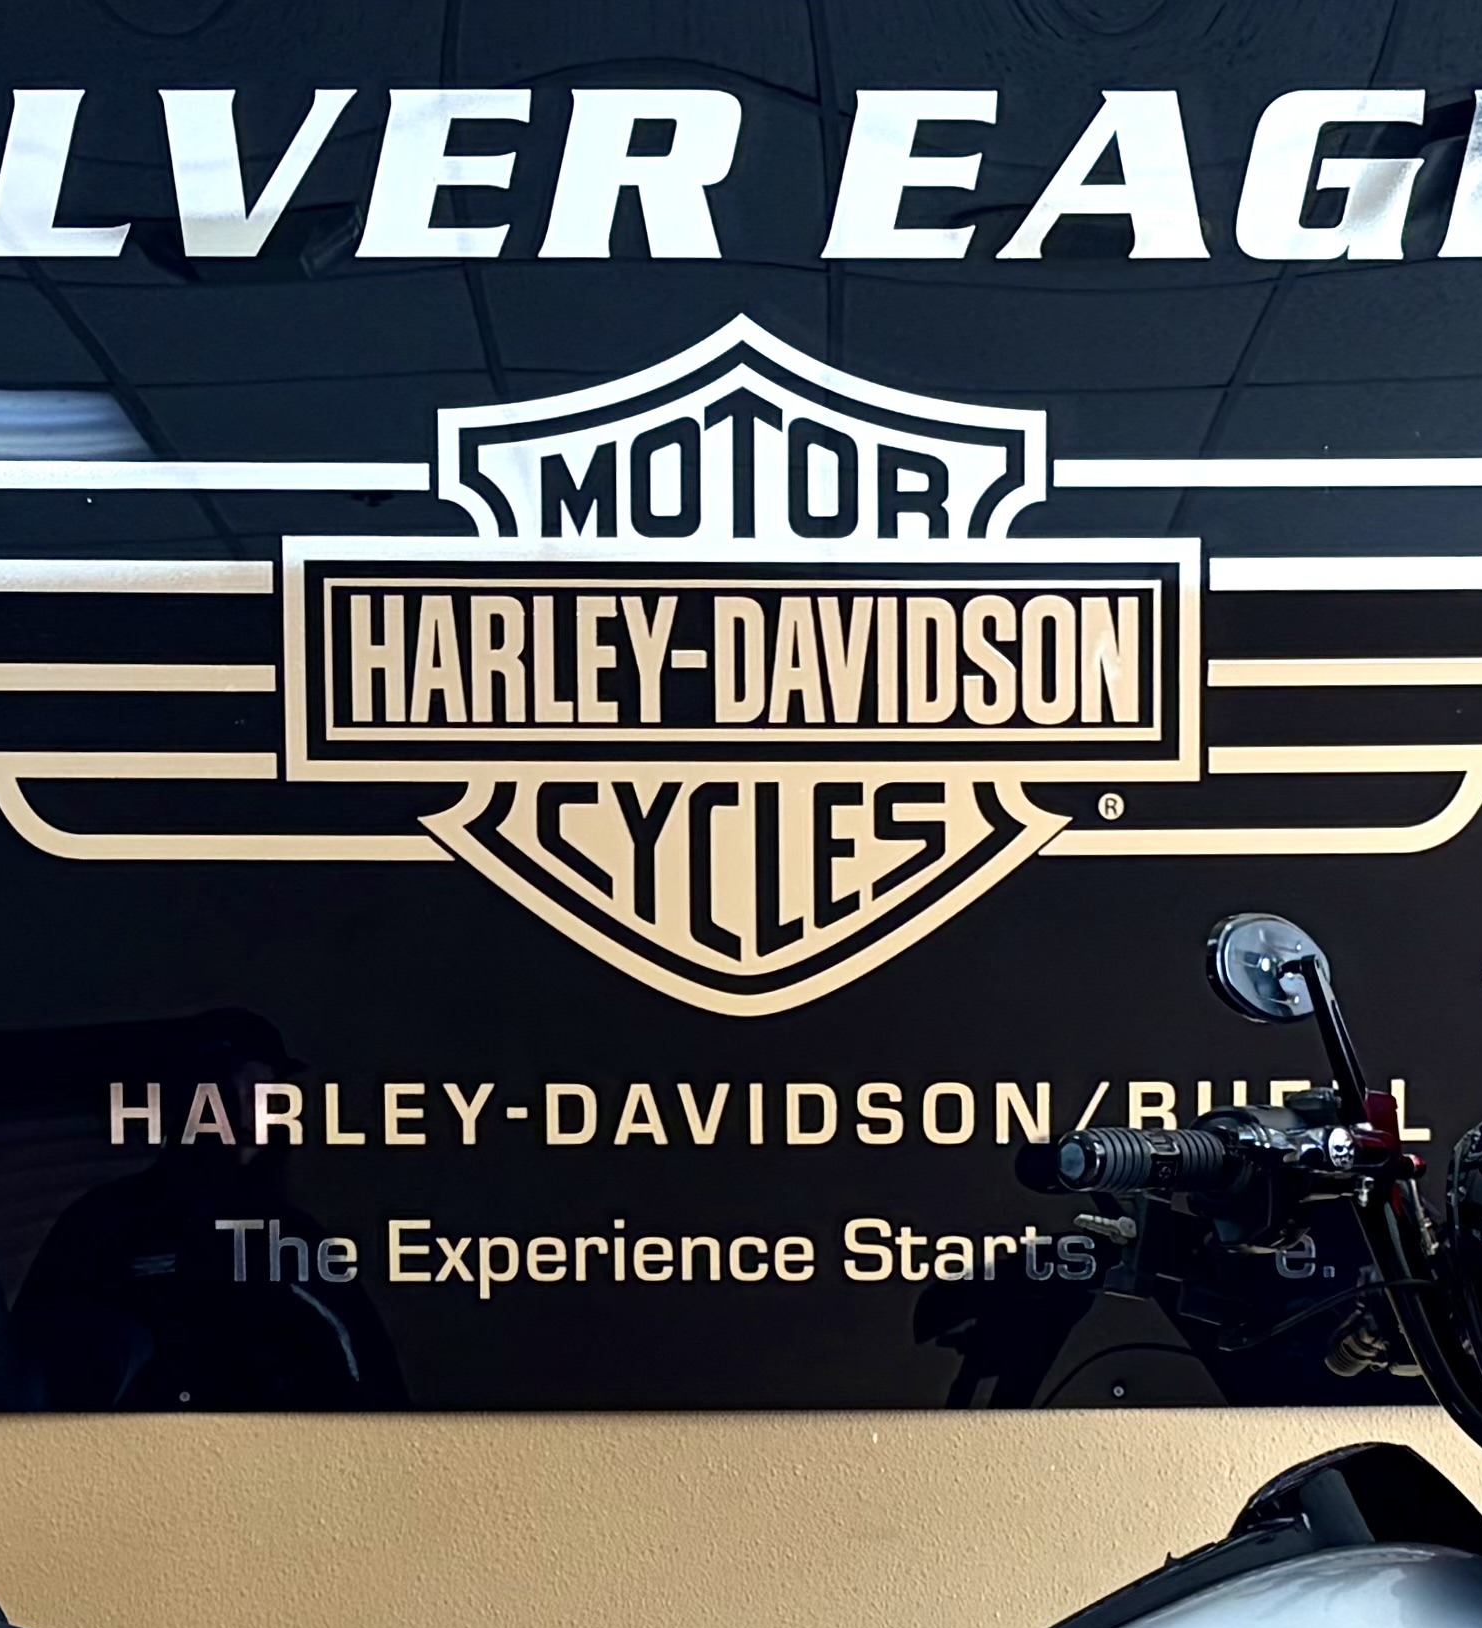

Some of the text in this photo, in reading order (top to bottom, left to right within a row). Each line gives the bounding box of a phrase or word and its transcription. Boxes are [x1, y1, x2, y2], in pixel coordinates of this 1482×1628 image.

[540, 386, 949, 539] MOTOR
[350, 594, 1140, 725] HARLEY-DAVIDSON
[536, 780, 946, 962] CYCLES
[110, 1078, 1431, 1146] HARLEY-DAVIDSON/BL
[214, 1217, 1097, 1300] The Experience Starts
